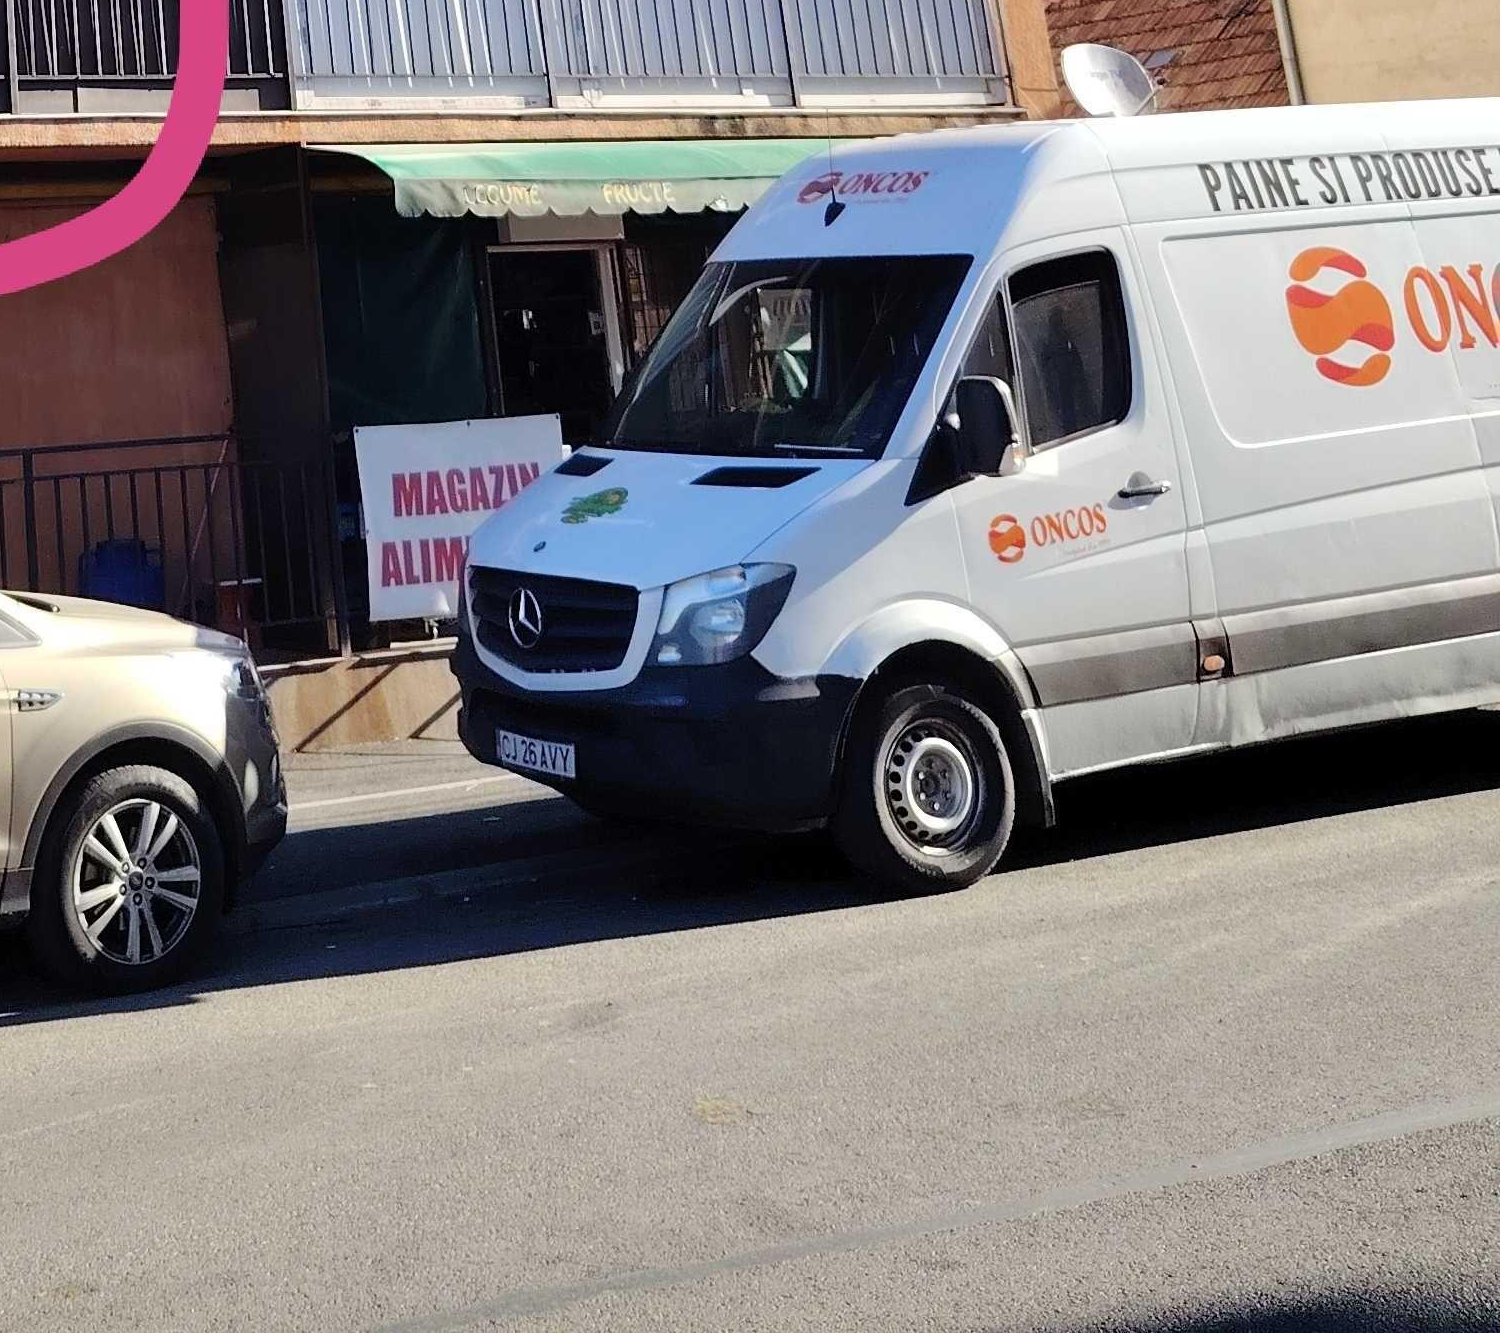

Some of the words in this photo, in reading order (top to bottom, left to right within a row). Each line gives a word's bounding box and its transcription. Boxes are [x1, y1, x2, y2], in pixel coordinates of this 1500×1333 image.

[602, 182, 677, 205] FRUCTE
[838, 172, 930, 195] ONCOS
[1196, 159, 1310, 211] PAINE
[1309, 156, 1350, 204] SI
[1350, 148, 1500, 202] PRODUSE
[1404, 262, 1500, 352] ON
[1031, 502, 1107, 547] ONCOS
[381, 535, 470, 587] ALIM
[502, 734, 518, 761] CJ
[521, 739, 537, 766] 26
[541, 743, 570, 772] AVY
